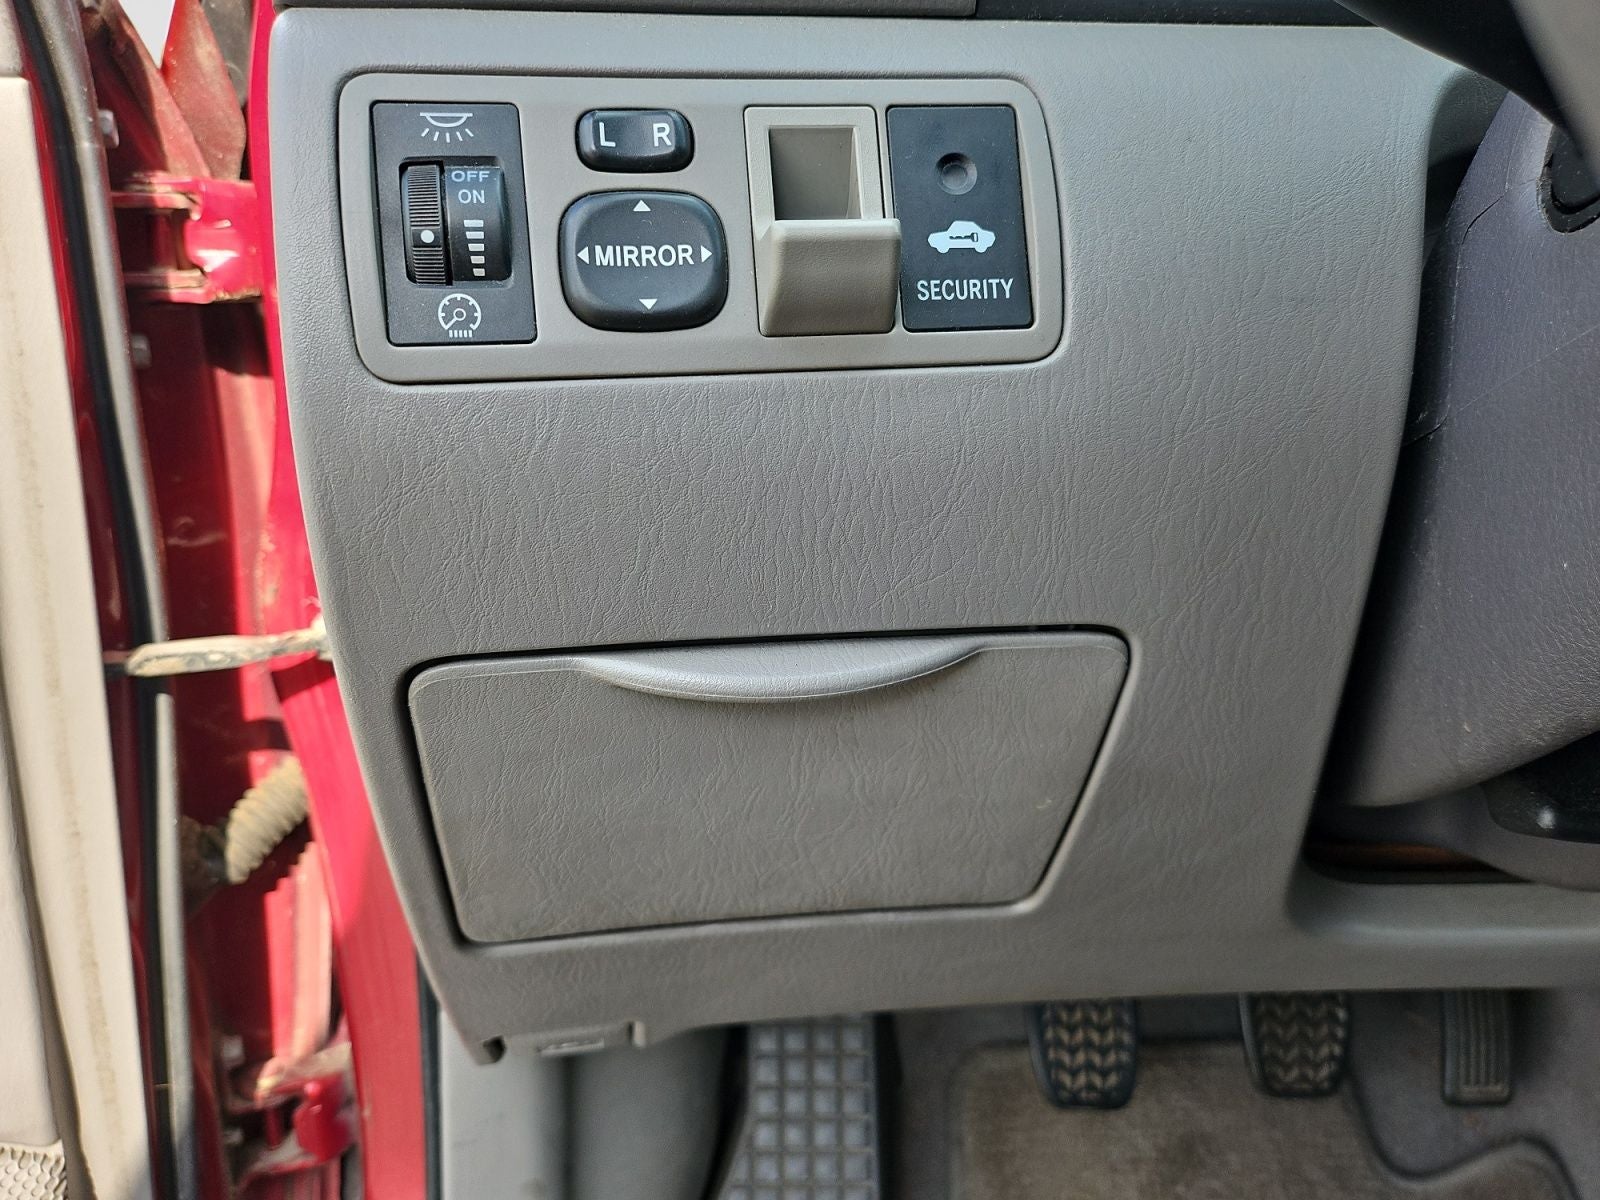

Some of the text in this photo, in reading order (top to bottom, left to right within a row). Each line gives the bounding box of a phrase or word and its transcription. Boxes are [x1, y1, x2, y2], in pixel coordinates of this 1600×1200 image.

[599, 122, 672, 147] L R
[451, 170, 490, 183] OFF
[458, 189, 486, 204] ON
[594, 244, 694, 267] MIRROR
[916, 278, 1014, 301] SECURITY
